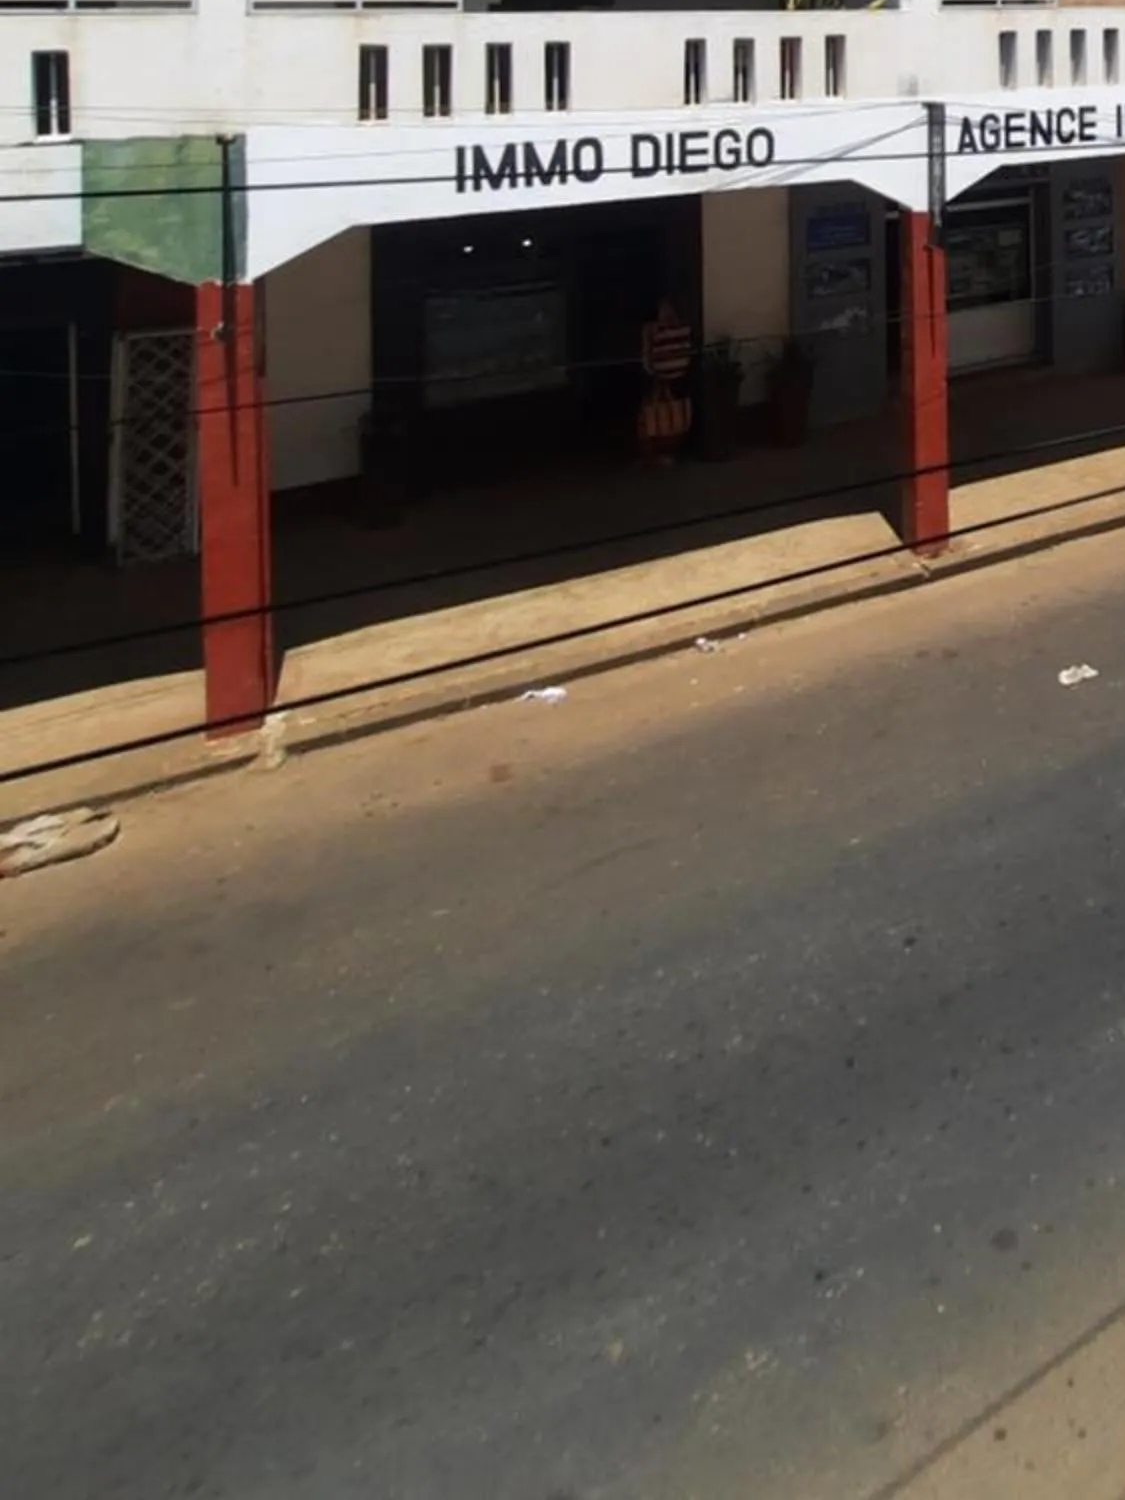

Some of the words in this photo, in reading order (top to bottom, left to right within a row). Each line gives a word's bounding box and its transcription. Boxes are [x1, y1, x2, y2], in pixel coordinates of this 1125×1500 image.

[957, 106, 1098, 154] AGENCE
[455, 137, 603, 194] IMMO
[630, 127, 776, 179] DIEGO
